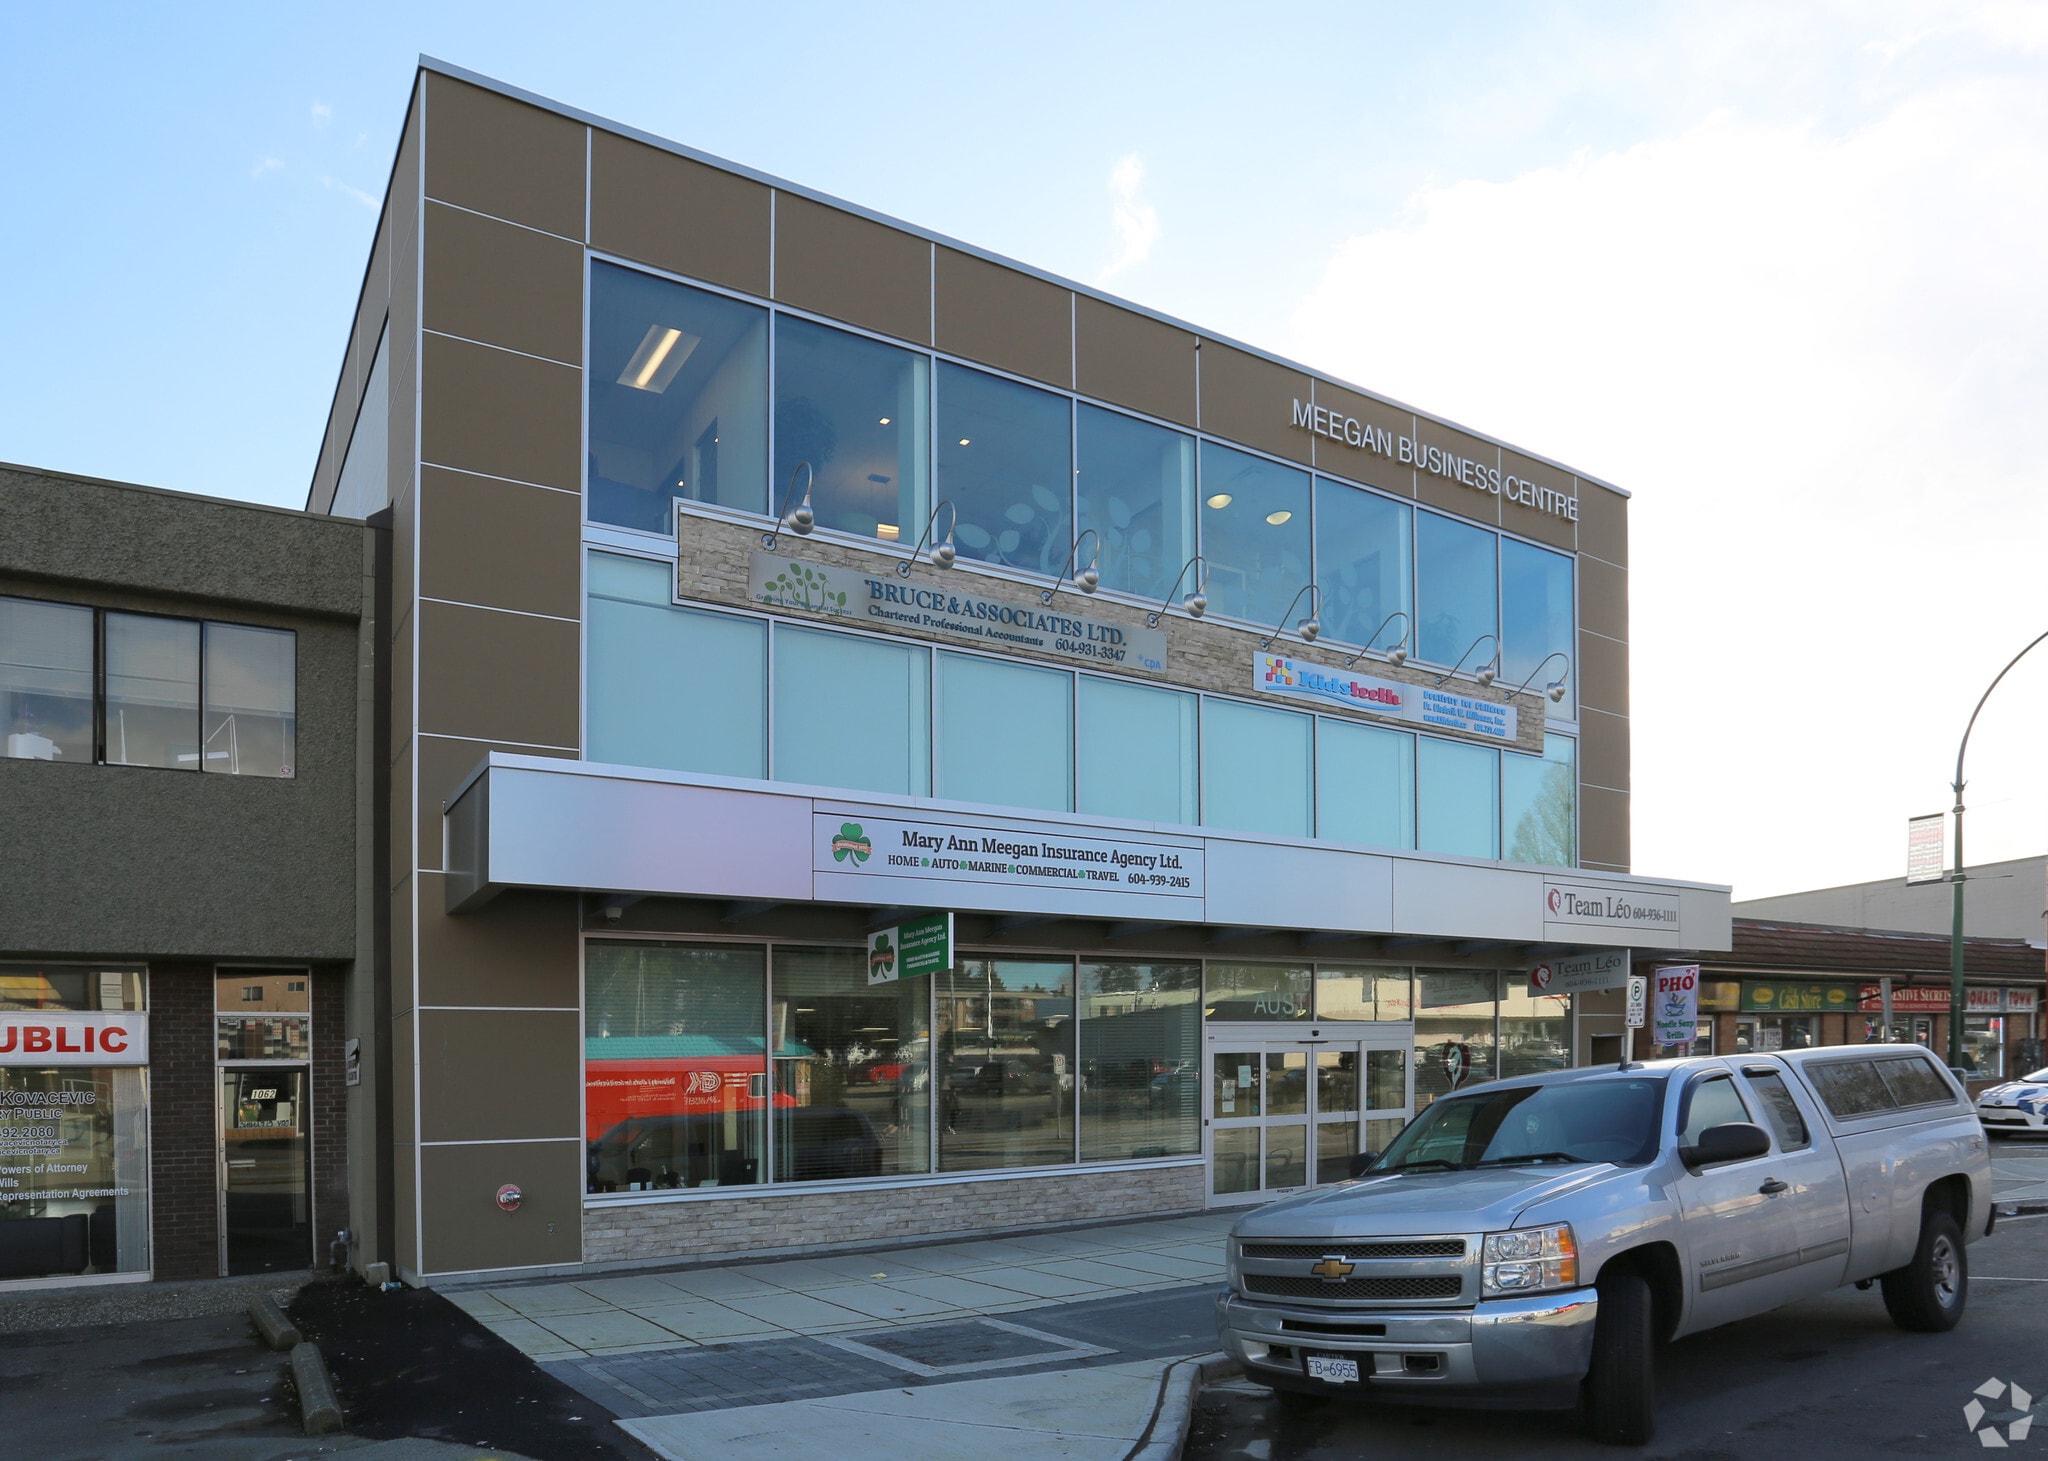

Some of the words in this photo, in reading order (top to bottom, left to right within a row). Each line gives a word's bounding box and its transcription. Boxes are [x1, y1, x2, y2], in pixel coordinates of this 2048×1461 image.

[1292, 398, 1392, 458] MEEGAN
[1399, 436, 1500, 495] BUSINESS
[1505, 475, 1579, 523] CENTRE
[868, 604, 920, 624] Chartered
[923, 614, 983, 635] Professional
[985, 626, 1043, 647] Accountants
[1088, 623, 1127, 647] LTD.
[1055, 637, 1126, 662] 604-931-3347
[902, 830, 944, 853] Mary
[947, 834, 978, 852] Ann
[982, 837, 1038, 859] Meegan
[1041, 842, 1108, 863] Insurance
[1110, 849, 1157, 870] Agency
[1159, 853, 1183, 870] Ltd.
[888, 854, 920, 867] HOME
[931, 858, 959, 870] AUTO
[968, 860, 1007, 874] MARINE
[1016, 864, 1079, 879] COMMERCIAL
[1086, 869, 1119, 882] TRAVEL
[1127, 872, 1190, 889] 604-939-2415
[1564, 892, 1604, 917] Team
[1606, 896, 1632, 919] Léo
[1633, 907, 1677, 923] 604-936-1111
[1555, 961, 1591, 975] Team
[1595, 955, 1622, 970] Léo
[1779, 988, 1799, 1009] Cash
[1800, 990, 1822, 1009] Store
[1920, 988, 1951, 1002] SECRETS
[2008, 991, 2032, 1006] TOWN
[0, 1090, 96, 1105] KOVACEVIC
[252, 1089, 276, 1099] 1062
[14, 1107, 64, 1120] PUBLIC
[0, 1126, 54, 1138] 92.2080
[0, 1147, 61, 1156] cevicnotary.ca
[0, 1165, 31, 1174] owers
[34, 1163, 45, 1173] of
[46, 1163, 88, 1174] Attorney
[71, 1186, 129, 1200] Agreements
